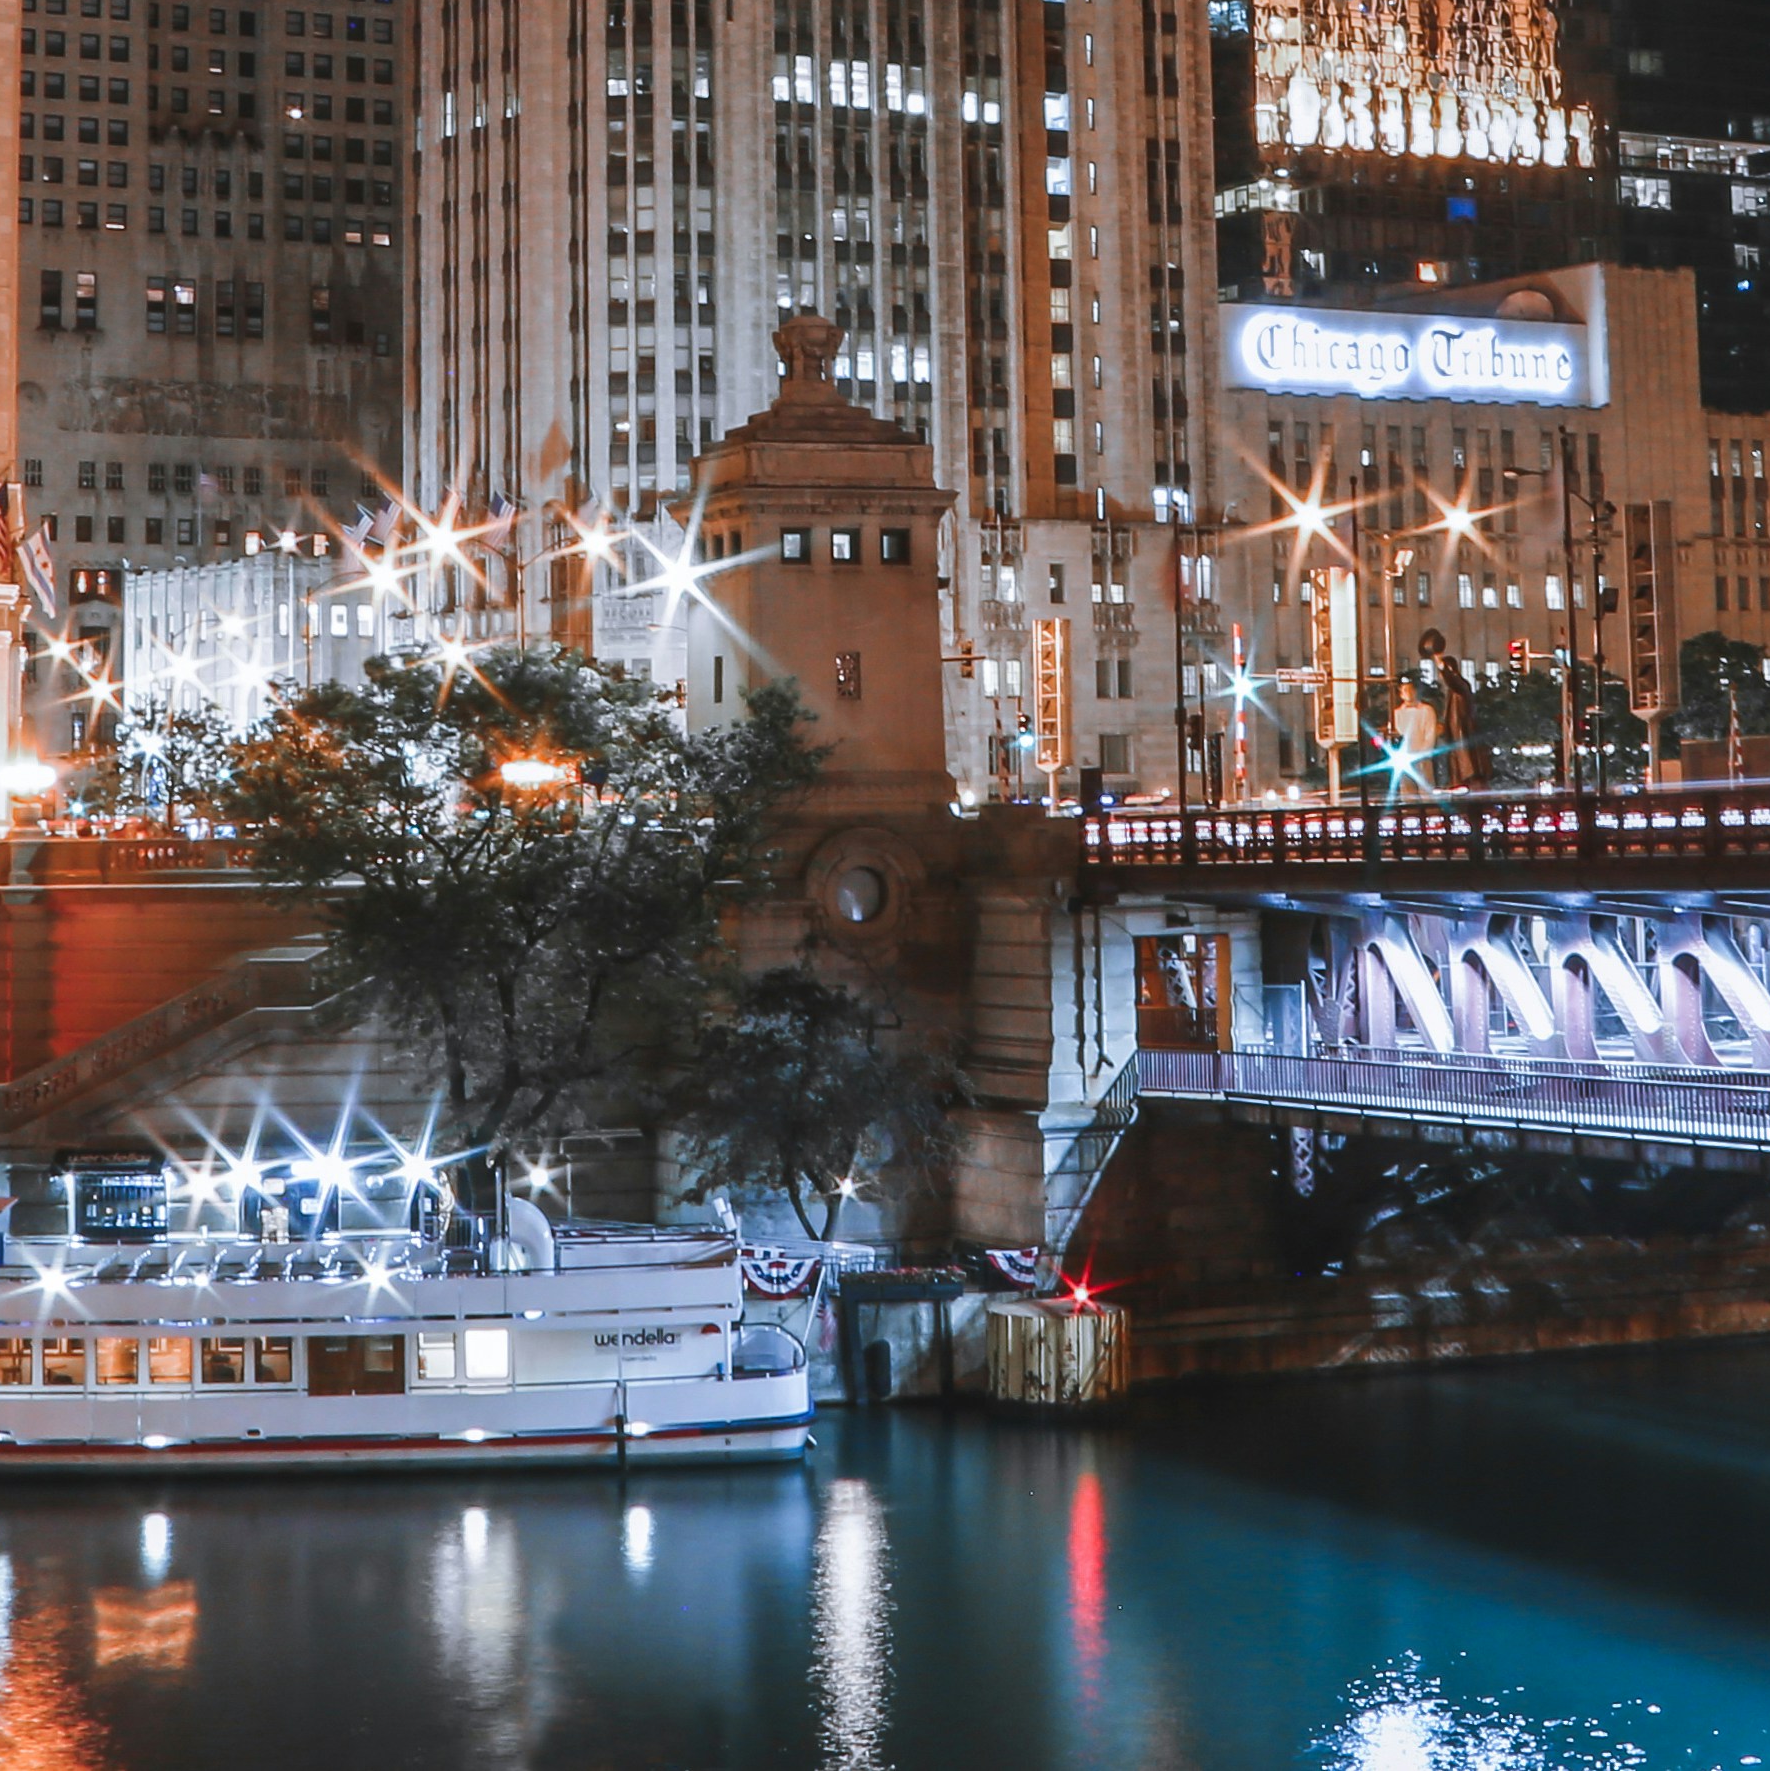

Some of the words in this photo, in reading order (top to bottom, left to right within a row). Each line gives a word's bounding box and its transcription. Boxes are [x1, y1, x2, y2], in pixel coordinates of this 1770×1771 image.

[1256, 322, 1410, 381] Chicago
[1431, 328, 1574, 381] Tribune
[594, 1328, 675, 1347] wendella
